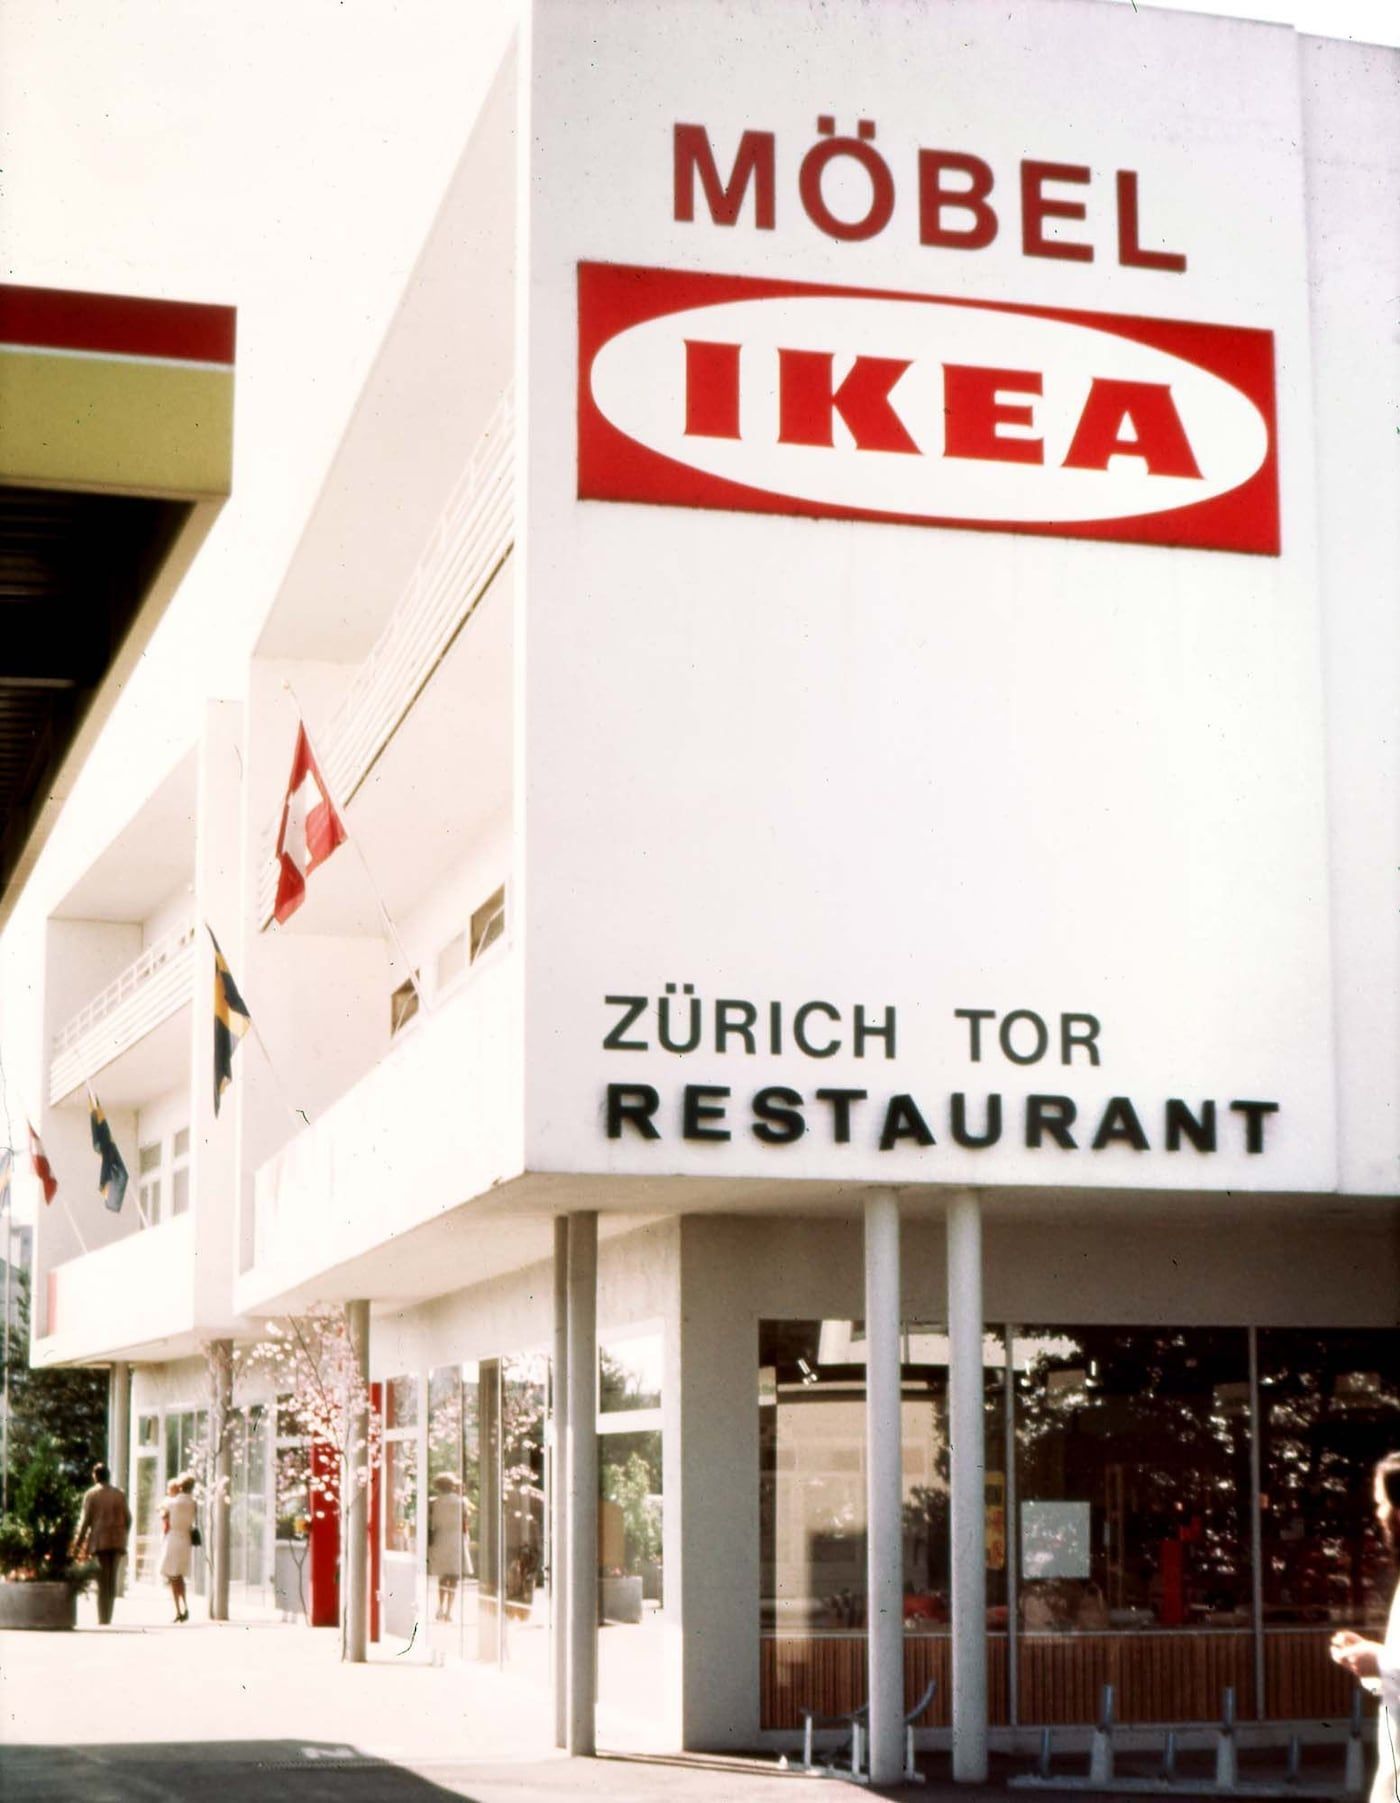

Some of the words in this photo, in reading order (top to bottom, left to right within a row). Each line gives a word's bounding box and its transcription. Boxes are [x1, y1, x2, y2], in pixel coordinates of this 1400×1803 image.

[673, 115, 1187, 273] MÖBEL
[684, 340, 1203, 479] IKEA
[602, 983, 896, 1059] ZÜRICH
[954, 1008, 1101, 1067] TOR
[604, 1082, 1280, 1155] RESTAURANT
